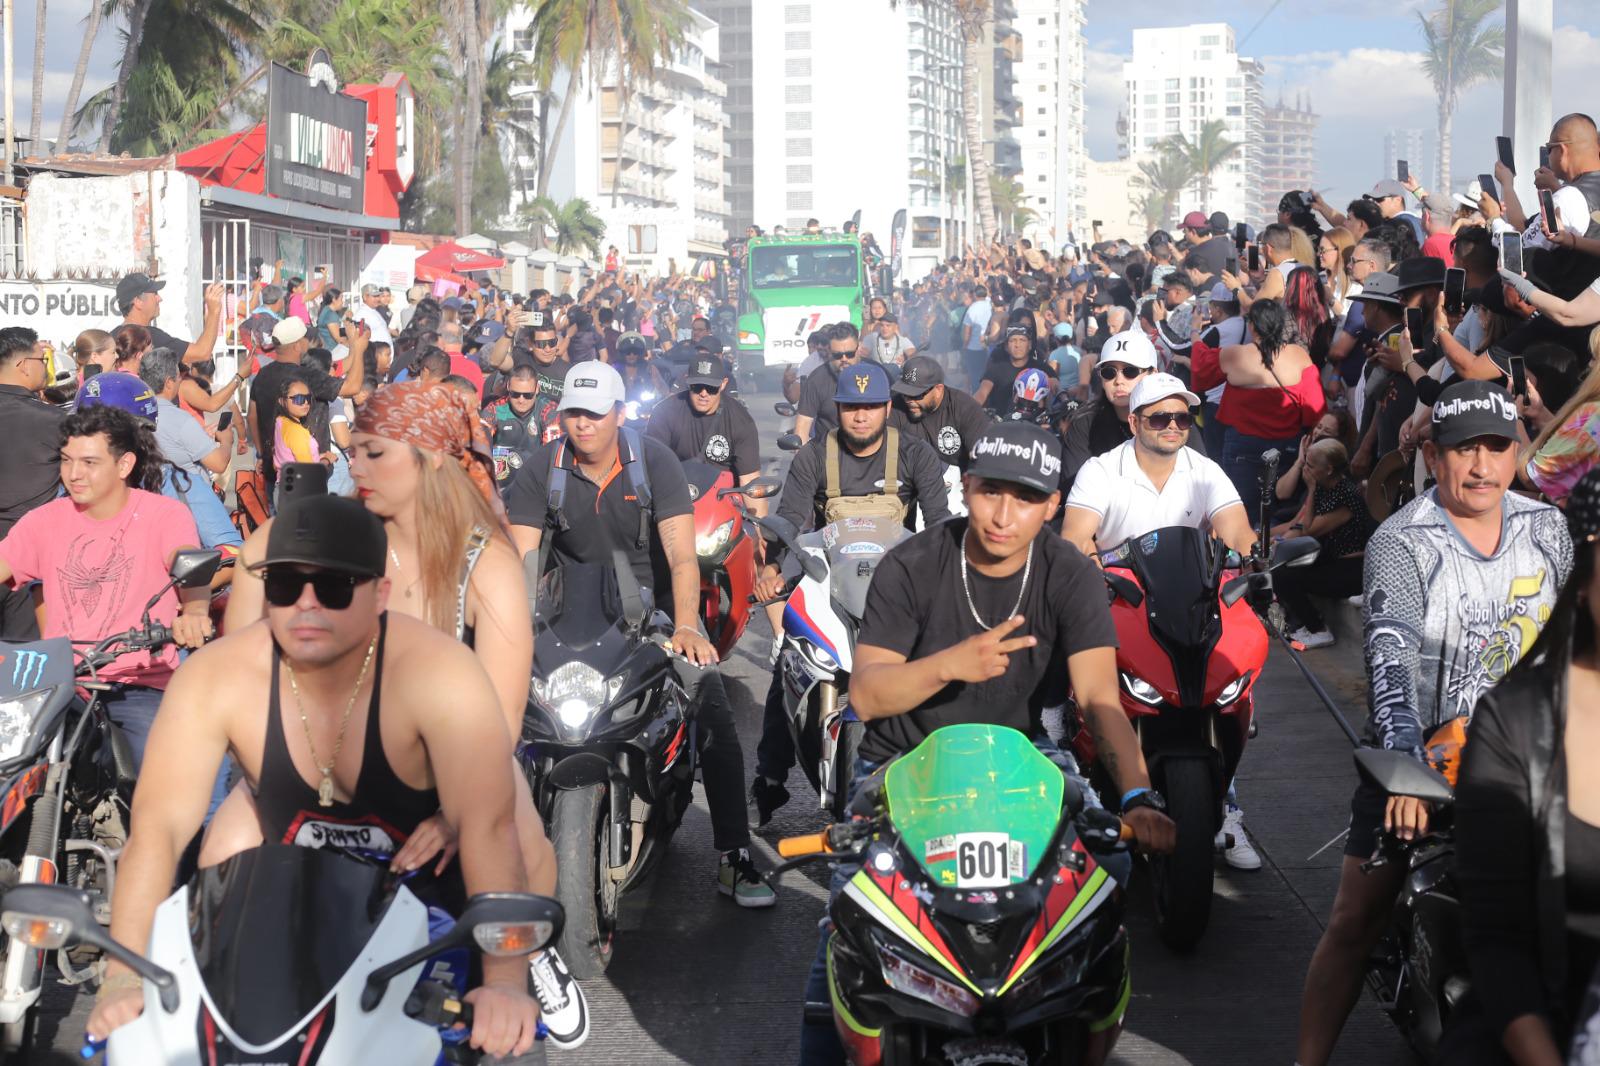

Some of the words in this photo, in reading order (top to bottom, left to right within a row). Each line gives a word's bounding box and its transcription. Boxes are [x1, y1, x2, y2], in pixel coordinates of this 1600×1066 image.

[774, 340, 806, 348] PRO
[310, 823, 371, 846] SANTO
[958, 840, 1008, 880] 601
